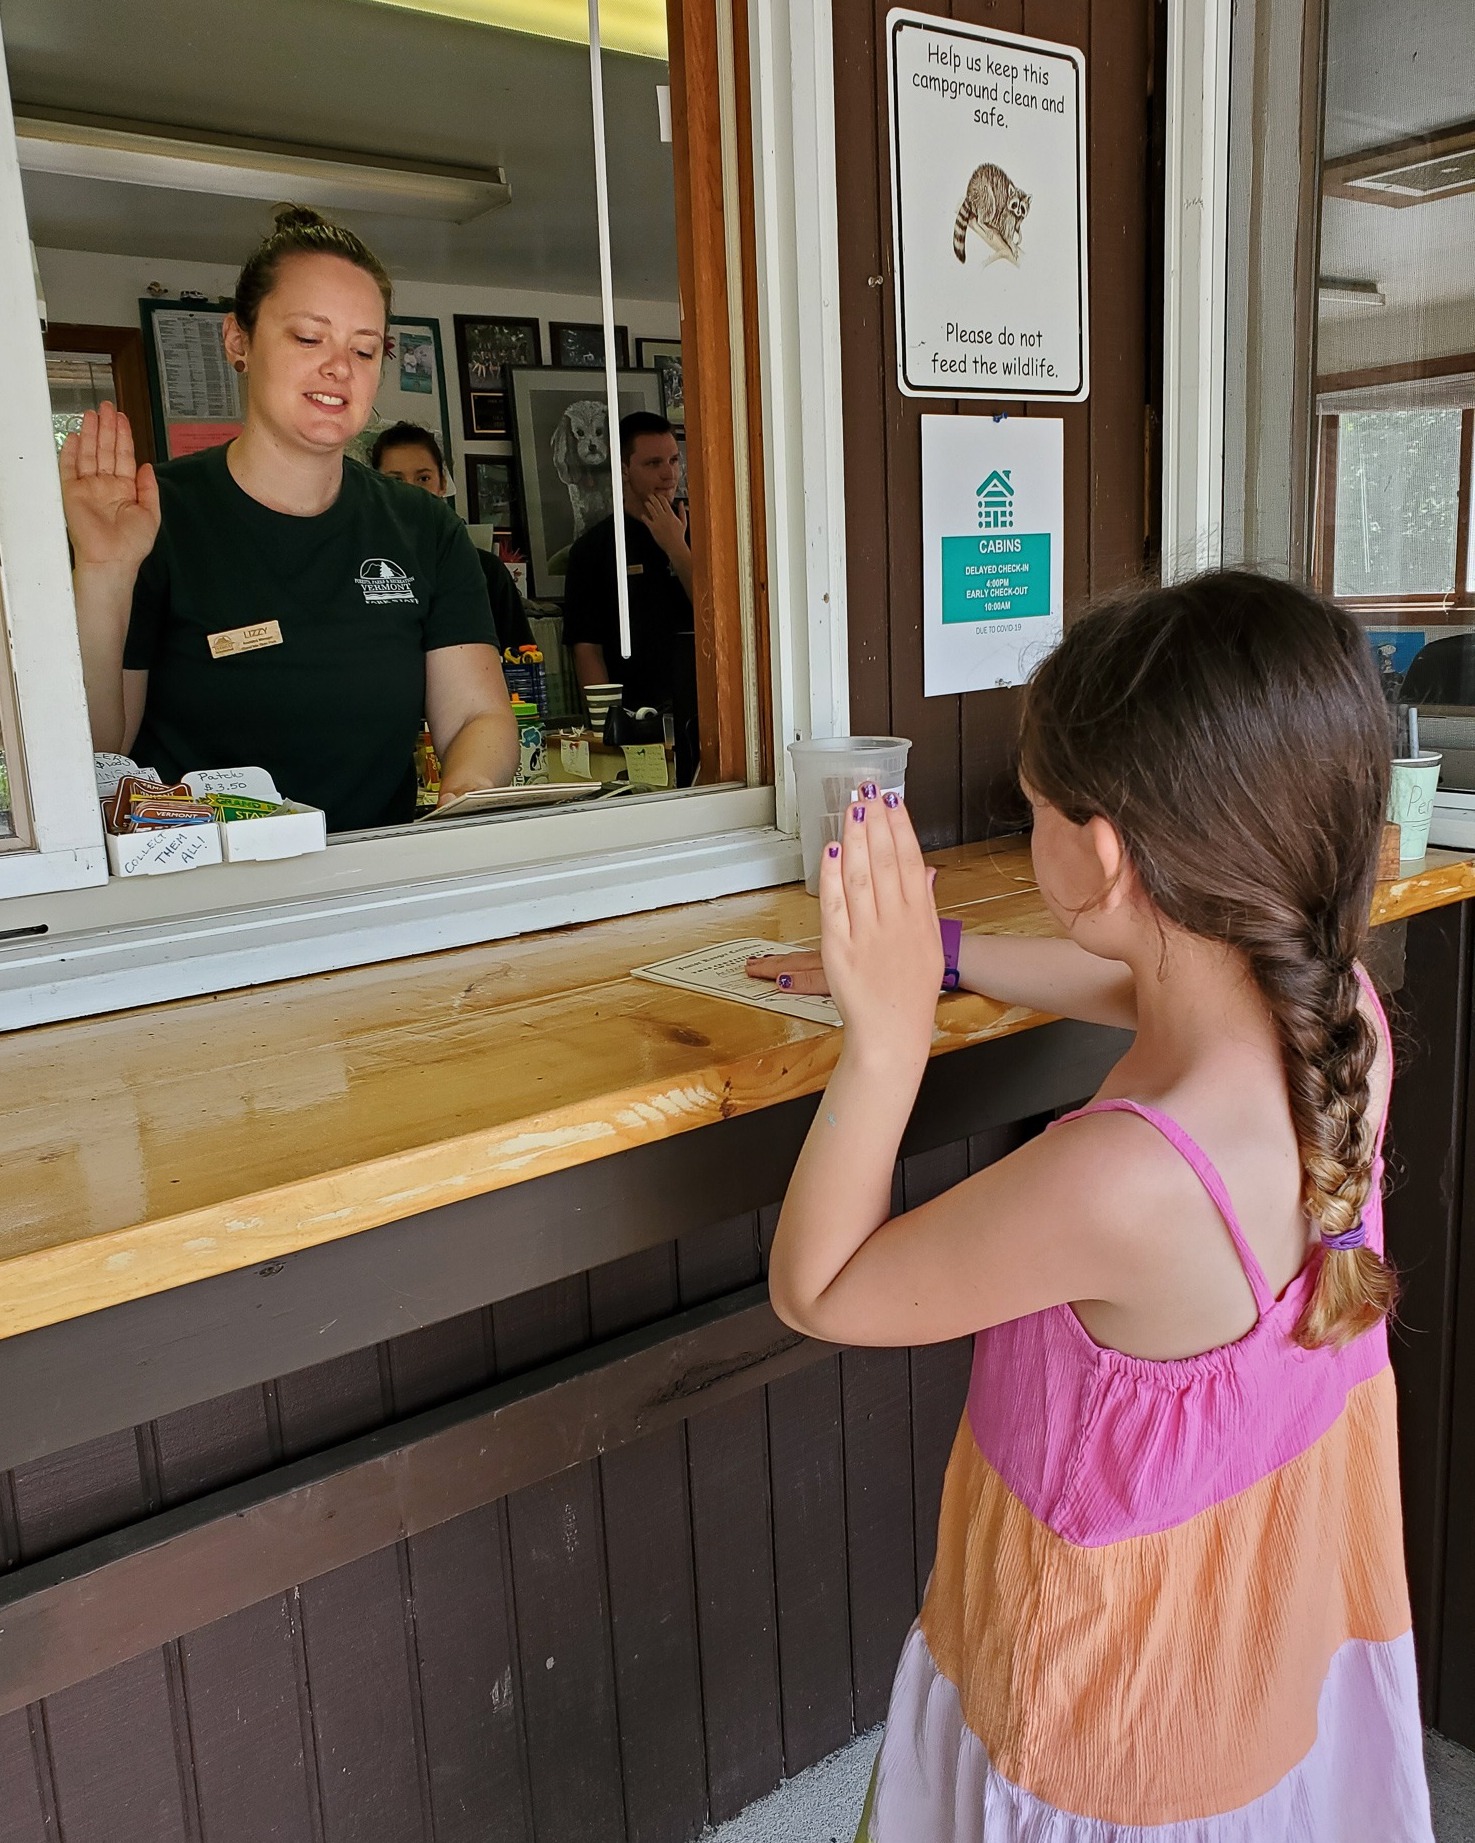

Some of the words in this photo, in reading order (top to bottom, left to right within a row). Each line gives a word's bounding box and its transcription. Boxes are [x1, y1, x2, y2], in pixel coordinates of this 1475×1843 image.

[928, 43, 961, 73] Help
[966, 56, 981, 72] us
[986, 54, 1019, 84] keep
[1023, 63, 1049, 85] this
[912, 72, 998, 101] campground
[1003, 85, 1038, 110] clean
[1041, 95, 1065, 114] and
[973, 106, 1008, 128] safe.
[946, 322, 993, 345] Please
[998, 325, 1015, 346] do
[1020, 330, 1043, 348] not
[931, 352, 967, 374] feed
[972, 354, 998, 375] the
[1002, 356, 1058, 378] wildlife.
[979, 539, 1021, 553] CABINS
[965, 565, 998, 575] DELAYED
[998, 563, 1029, 574] CHECK-IN
[361, 583, 411, 591] VERMONT
[986, 578, 1010, 588] 4:00PM
[966, 589, 989, 599] EARLY
[990, 586, 1029, 597] CHECK-OUT
[984, 601, 1011, 612] 10:00AM
[243, 627, 268, 639] LIZZY
[975, 626, 988, 635] DUE
[989, 625, 996, 633] TO
[996, 623, 1022, 633] COVID-19
[156, 811, 199, 819] VERMONT
[124, 832, 167, 874] COLLECT
[154, 833, 188, 864] THEM
[181, 835, 208, 864] ALL!
